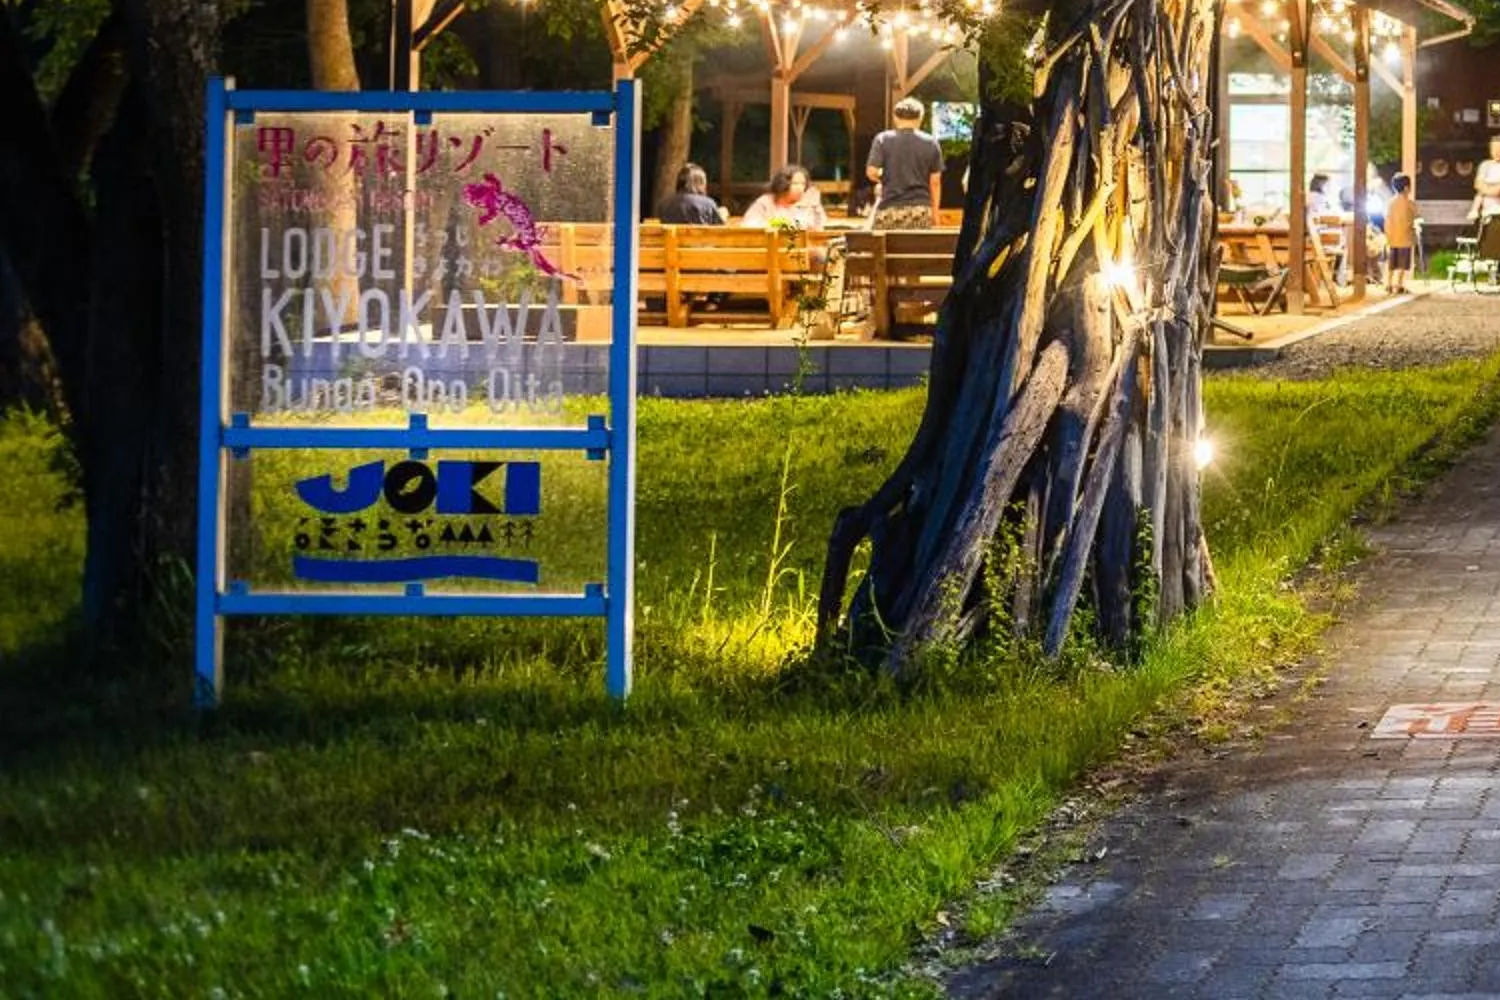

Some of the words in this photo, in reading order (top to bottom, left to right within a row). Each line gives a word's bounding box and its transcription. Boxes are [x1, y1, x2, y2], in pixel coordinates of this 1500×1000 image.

[257, 120, 568, 178] 里の旅リゾート
[260, 223, 396, 280] LODGE
[261, 286, 565, 360] KIYOKAWA
[295, 459, 541, 515] JOKI
